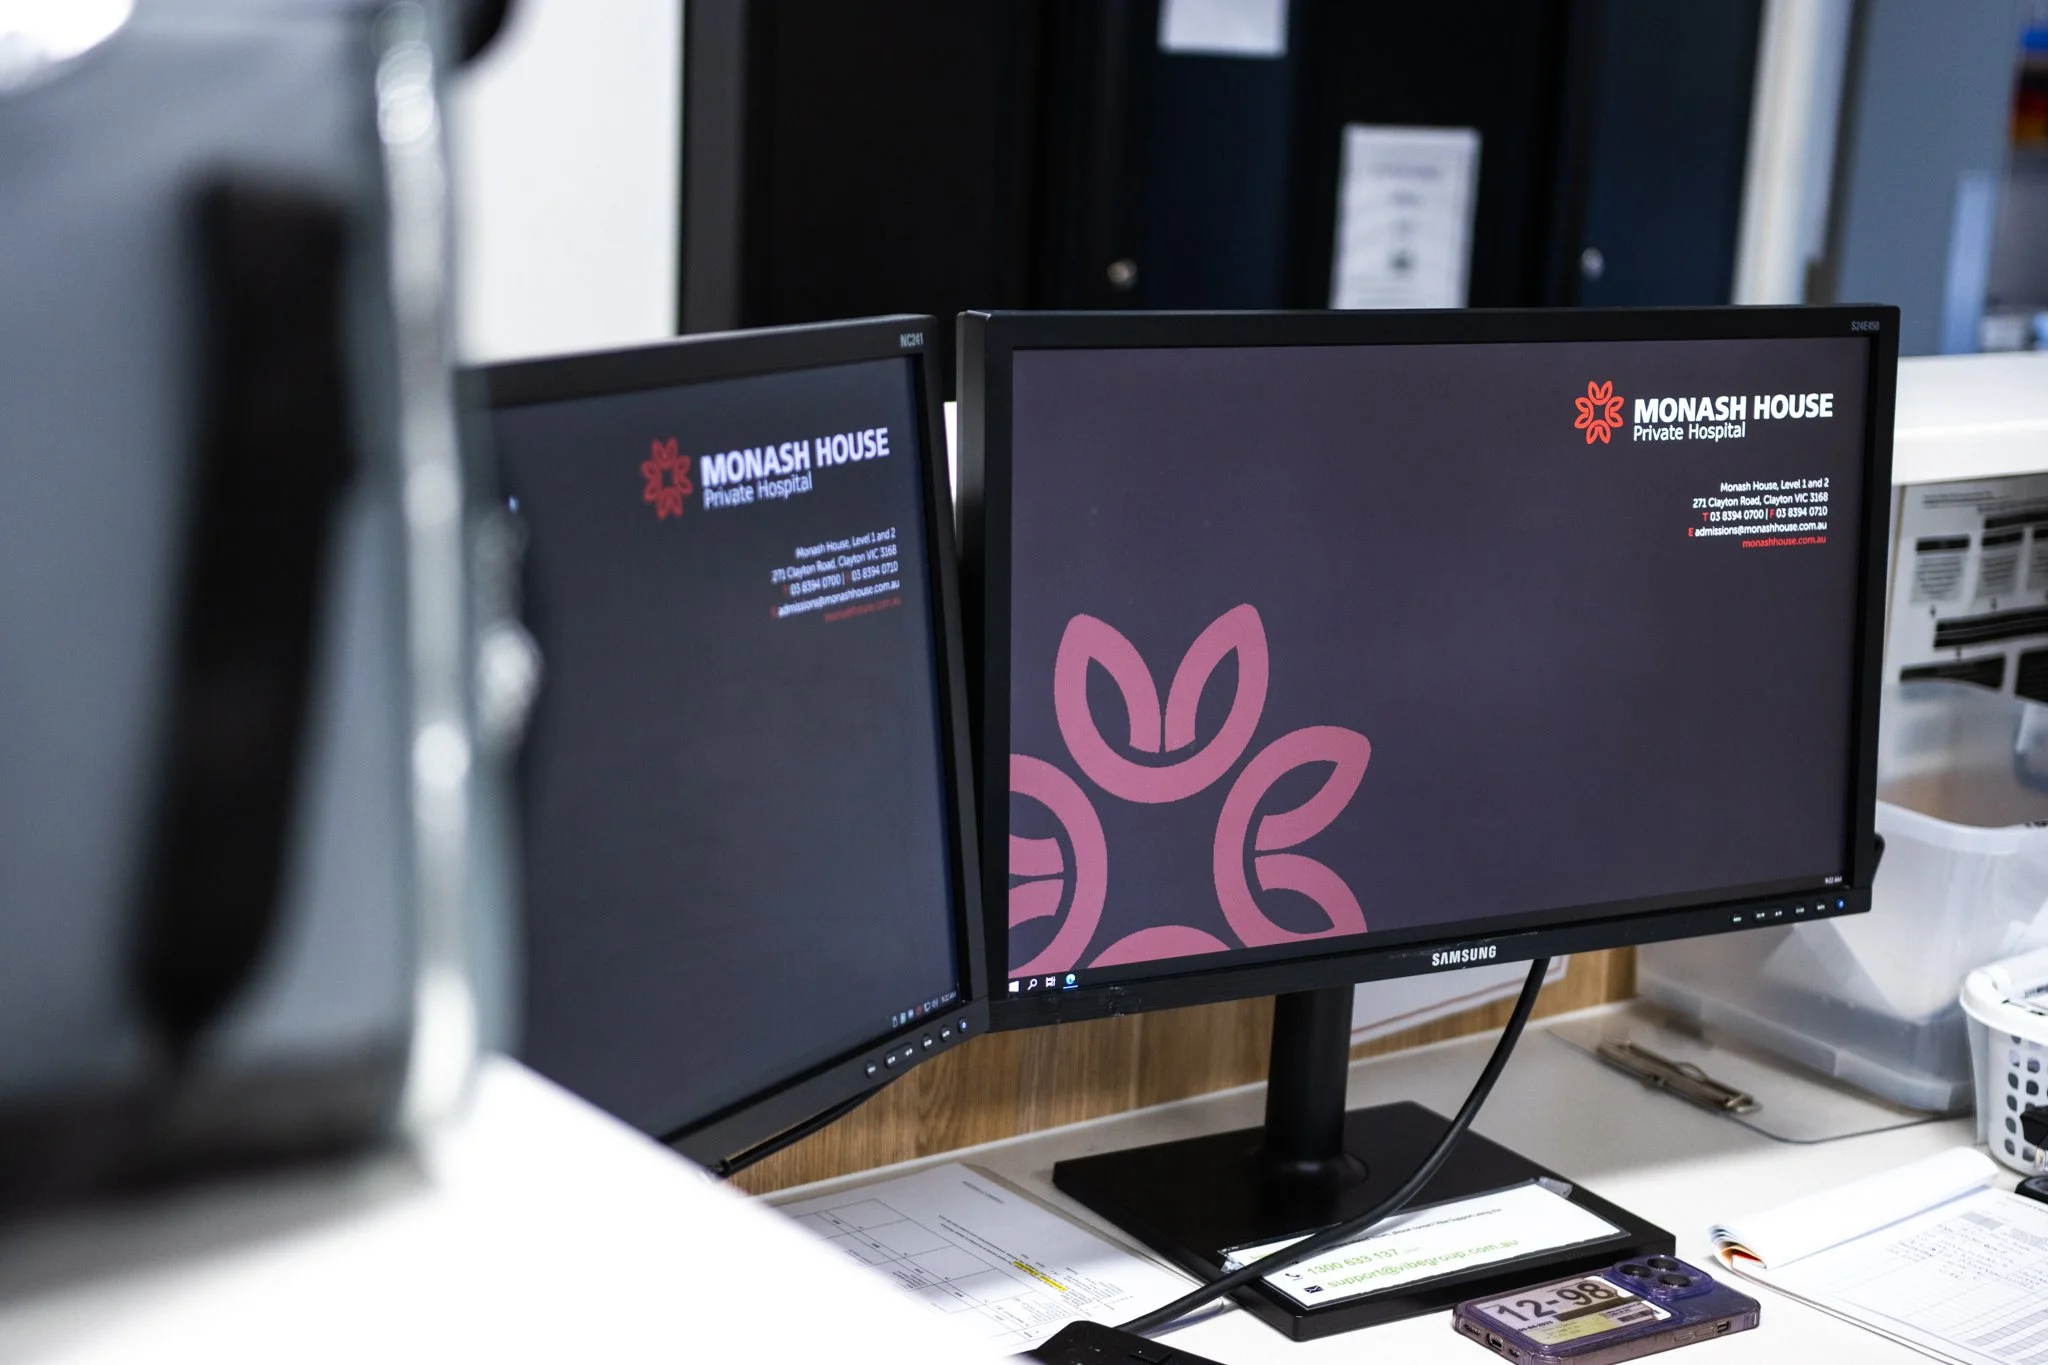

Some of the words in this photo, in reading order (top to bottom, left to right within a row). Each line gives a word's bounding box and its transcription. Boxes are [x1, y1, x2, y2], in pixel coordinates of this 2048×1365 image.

[1634, 395, 1747, 424] MONASH
[1753, 393, 1834, 420] HOUSE
[1633, 424, 1683, 441] Private
[1689, 421, 1746, 442] Hospital
[700, 440, 811, 487] MONASH
[815, 427, 890, 468] HOUSE
[703, 484, 754, 510] Private
[757, 471, 813, 500] Hospital
[1720, 482, 1751, 492] Monash
[1752, 480, 1779, 491] House,
[1781, 479, 1801, 489] Level
[1808, 478, 1823, 488] and
[1823, 477, 1830, 488] 2
[1692, 498, 1707, 508] 271
[1708, 497, 1739, 509] Clayton
[1740, 495, 1762, 506] Road,
[1763, 494, 1793, 506] Clayton
[1794, 493, 1809, 503] VIC
[1809, 492, 1829, 502] 3168
[1702, 512, 1709, 521] T
[1710, 511, 1721, 522] 03
[1722, 510, 1742, 521] 8394
[1743, 509, 1764, 520] 0700
[1769, 509, 1775, 519] F
[1775, 508, 1787, 519] 03
[1787, 507, 1808, 517] 8394
[1808, 506, 1828, 516] 0710
[1688, 527, 1694, 537] E
[1694, 521, 1828, 537] admissions@monashhouse.com.au
[1742, 536, 1827, 548] monashhouse.com.au
[795, 541, 826, 559] Monash
[851, 533, 871, 547] Level
[890, 527, 897, 539] 2
[786, 563, 816, 580] Clayton
[837, 554, 866, 568] Clayton
[1431, 945, 1497, 966] SAMSUNG
[1307, 1261, 1344, 1275] 1300
[1373, 1248, 1399, 1261] 137
[1327, 1239, 1519, 1288] support@vibegroup.com.au
[1497, 1283, 1613, 1322] 12-98
